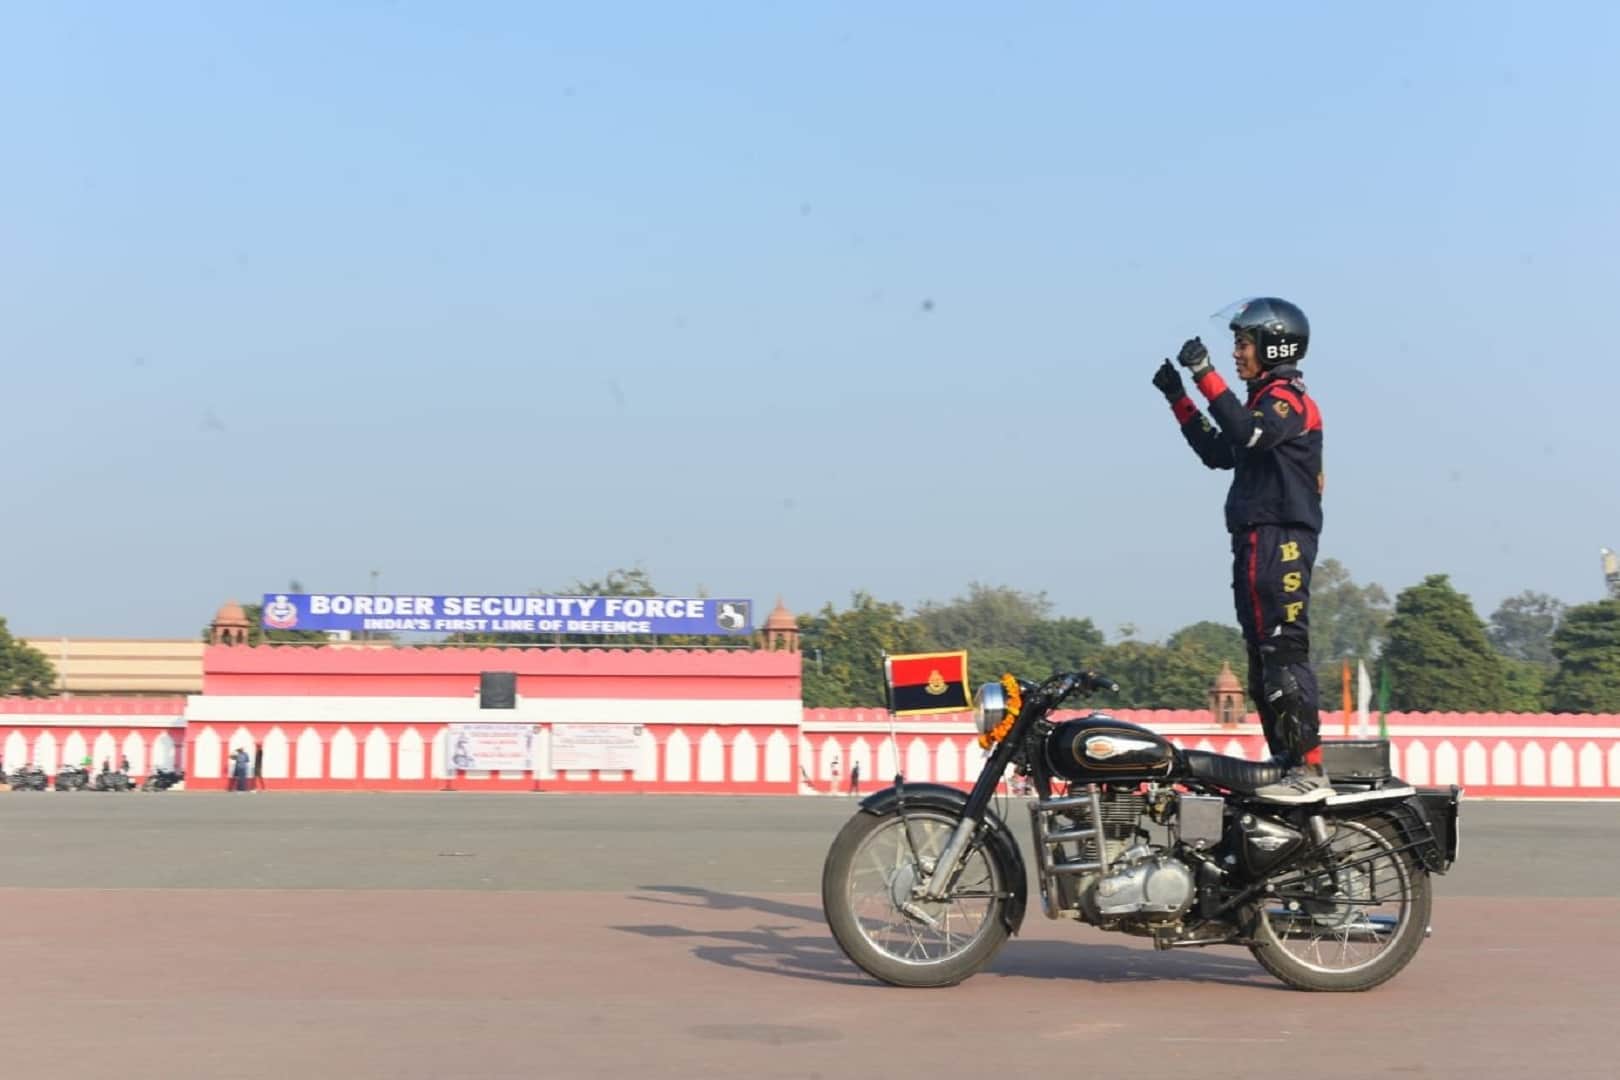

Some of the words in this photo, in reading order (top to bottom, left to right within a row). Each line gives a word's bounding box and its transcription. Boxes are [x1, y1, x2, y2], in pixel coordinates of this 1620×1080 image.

[1266, 343, 1299, 359] BSF
[1280, 541, 1304, 622] BSF
[310, 595, 436, 616] BORDER
[443, 596, 597, 618] SECURITY
[604, 599, 705, 619] FORCE
[363, 618, 431, 630] INDIA'S
[434, 619, 489, 631] FIRST
[492, 619, 536, 631] LINE
[538, 619, 563, 632] OF
[566, 620, 652, 633] DEFENCE
